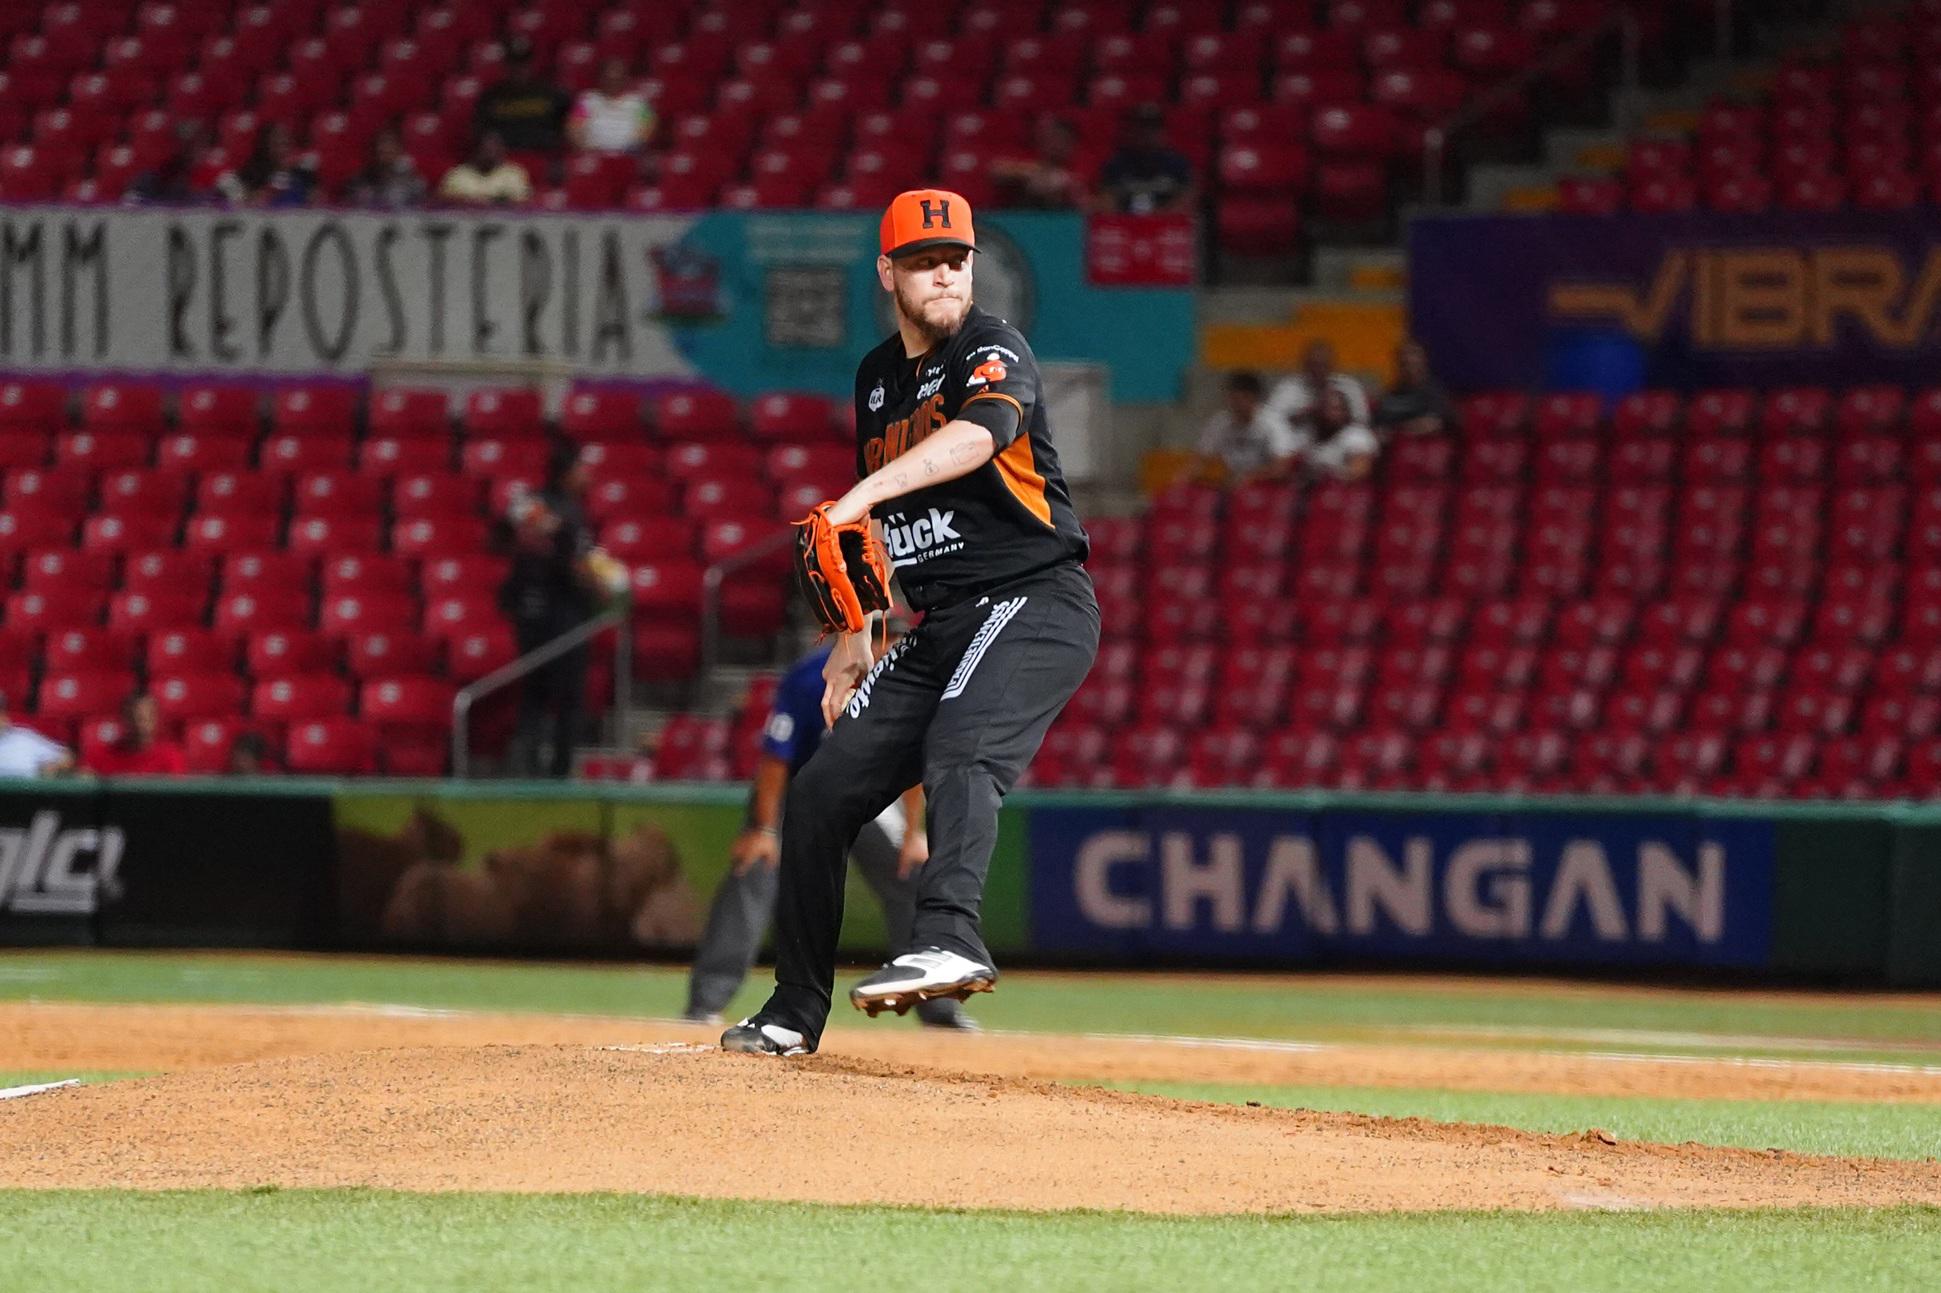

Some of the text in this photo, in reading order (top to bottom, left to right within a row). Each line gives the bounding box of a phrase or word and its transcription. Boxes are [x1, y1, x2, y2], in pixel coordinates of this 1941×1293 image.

[920, 199, 952, 229] H
[165, 217, 634, 364] REPOSTERIA
[917, 541, 965, 563] GERMANY
[1074, 831, 1726, 942] CHANGAN
